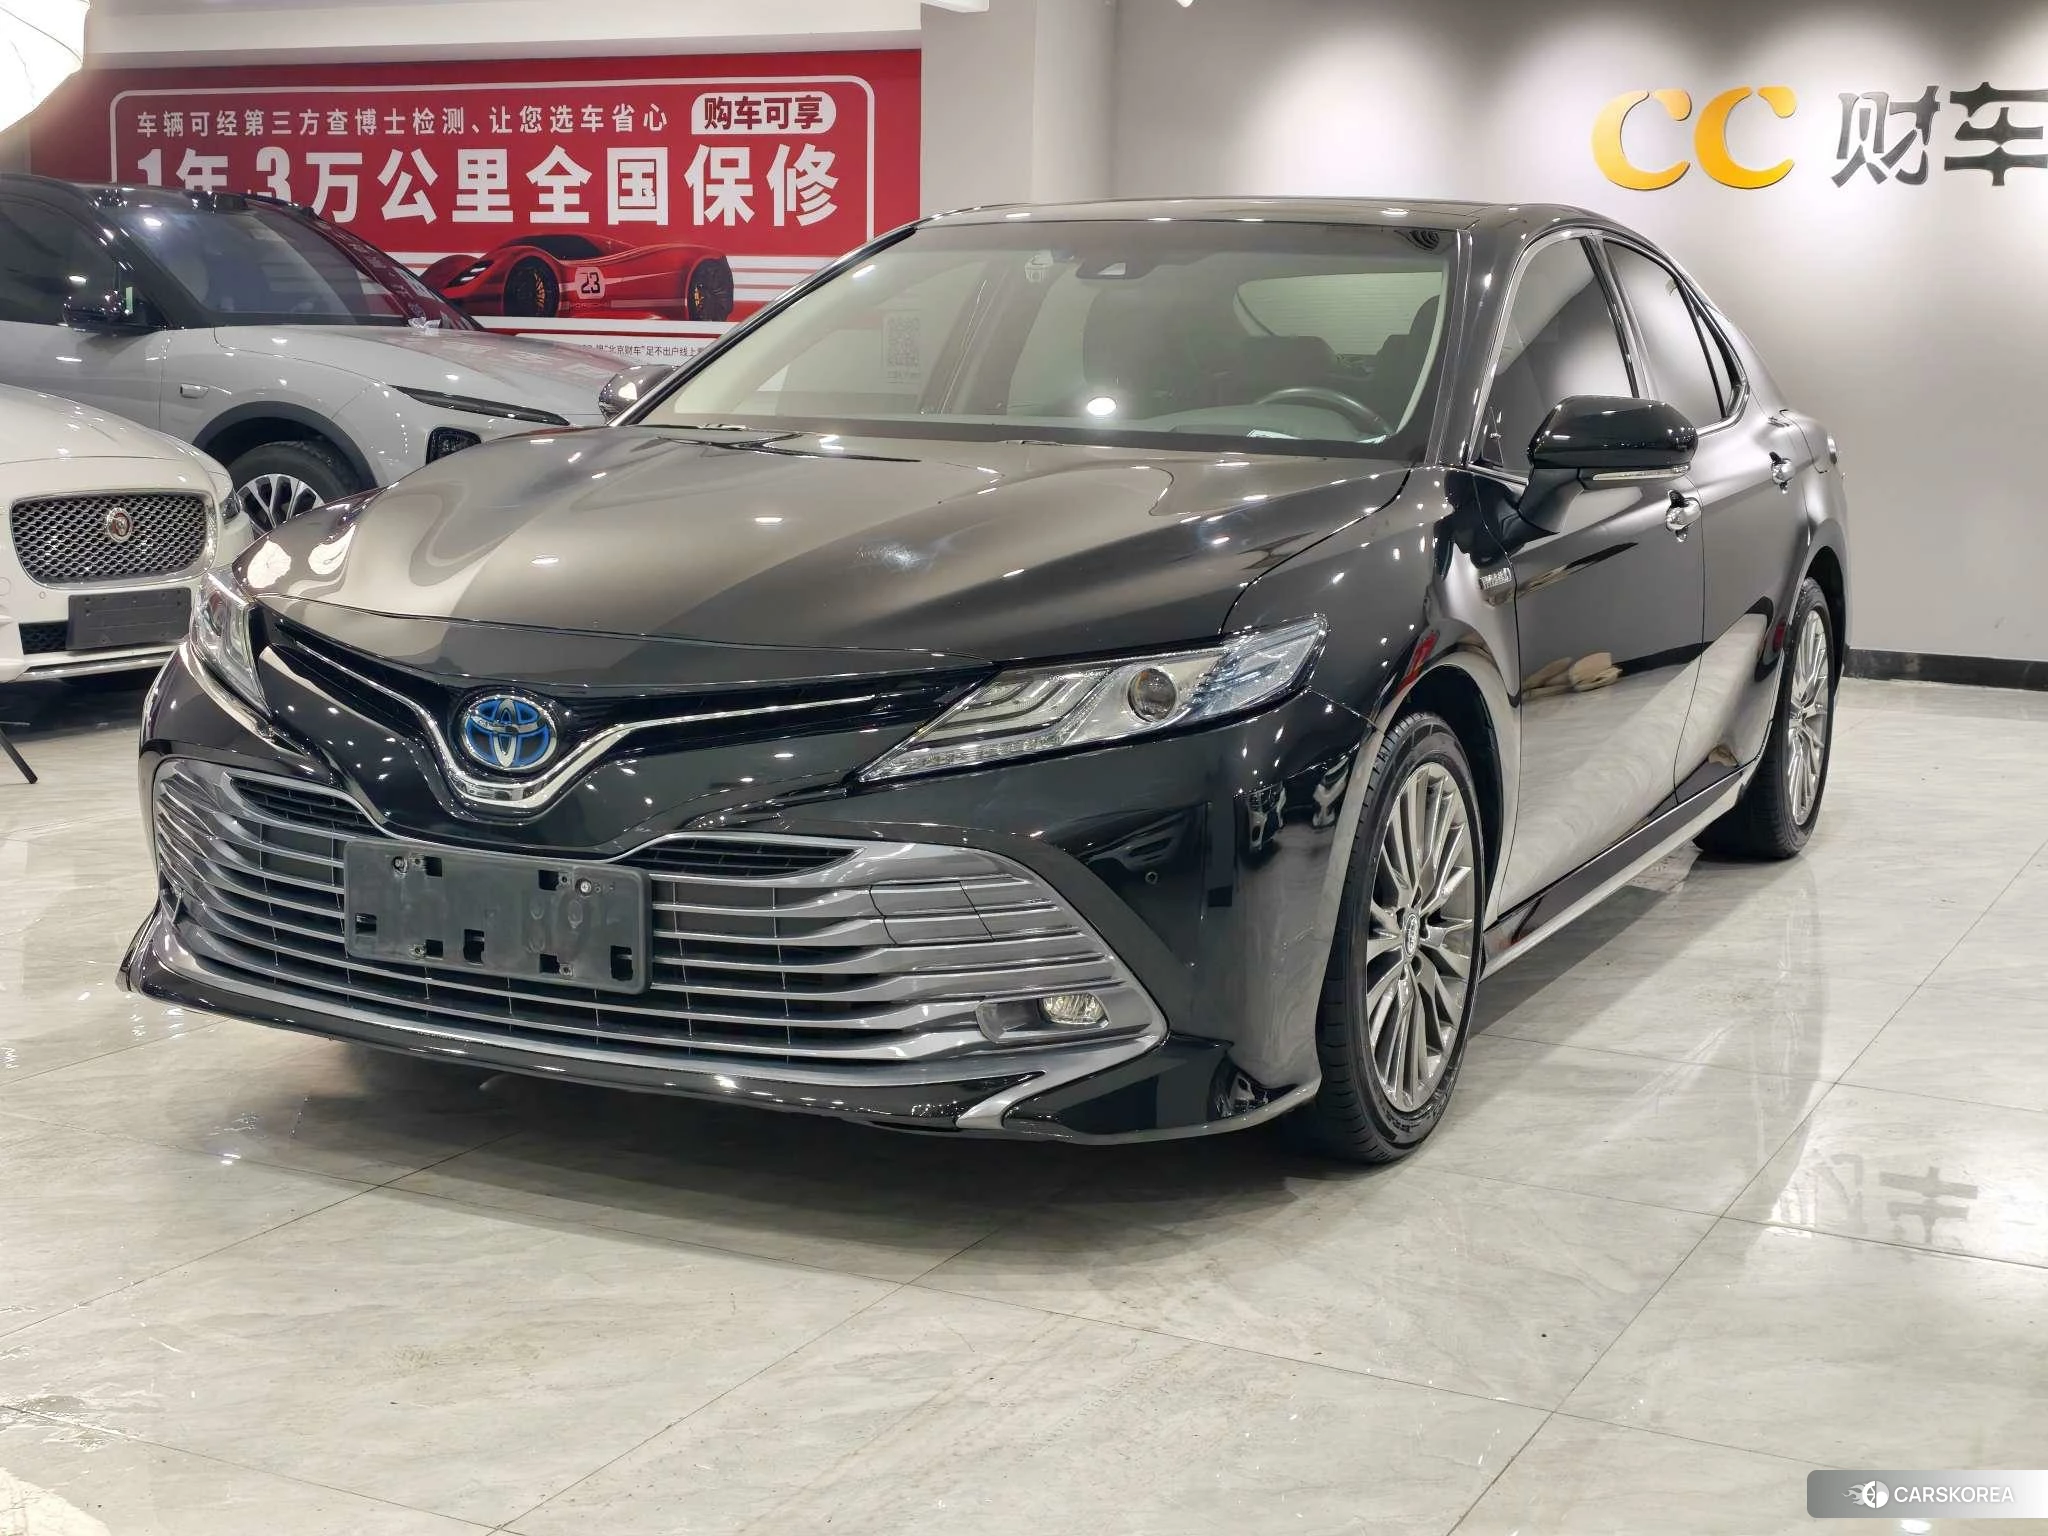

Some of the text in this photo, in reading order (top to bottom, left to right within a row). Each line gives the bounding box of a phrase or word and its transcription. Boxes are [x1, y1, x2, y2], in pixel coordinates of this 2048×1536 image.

[137, 103, 668, 138] 车辆可经第三方查博士检测、让您选车省心
[704, 95, 823, 130] 购车可享
[1591, 81, 2048, 190] CC 财车
[580, 271, 601, 294] 23
